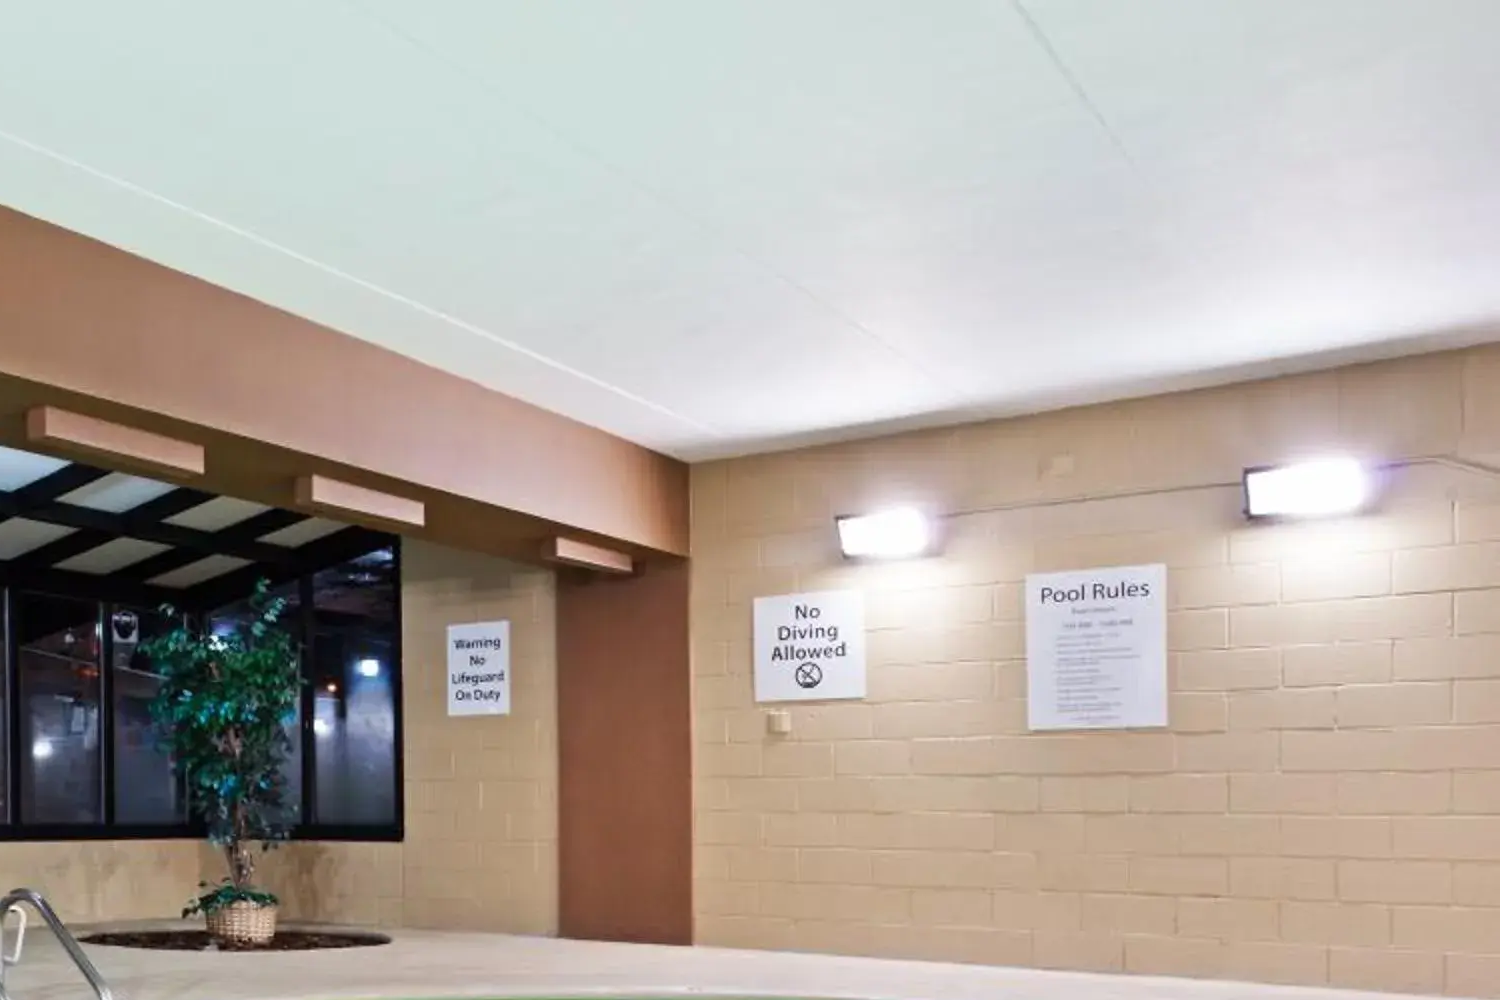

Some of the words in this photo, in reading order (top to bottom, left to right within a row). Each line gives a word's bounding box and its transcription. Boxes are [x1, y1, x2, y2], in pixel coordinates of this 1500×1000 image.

[1041, 584, 1086, 604] Pool
[1092, 581, 1150, 600] Rules
[794, 604, 821, 619] No
[777, 624, 838, 642] Diving
[453, 638, 501, 651] Warning
[771, 641, 846, 661] Allowed
[469, 655, 486, 667] No
[451, 670, 505, 686] Lifeguard
[455, 689, 472, 701] On
[474, 689, 501, 702] Duty
